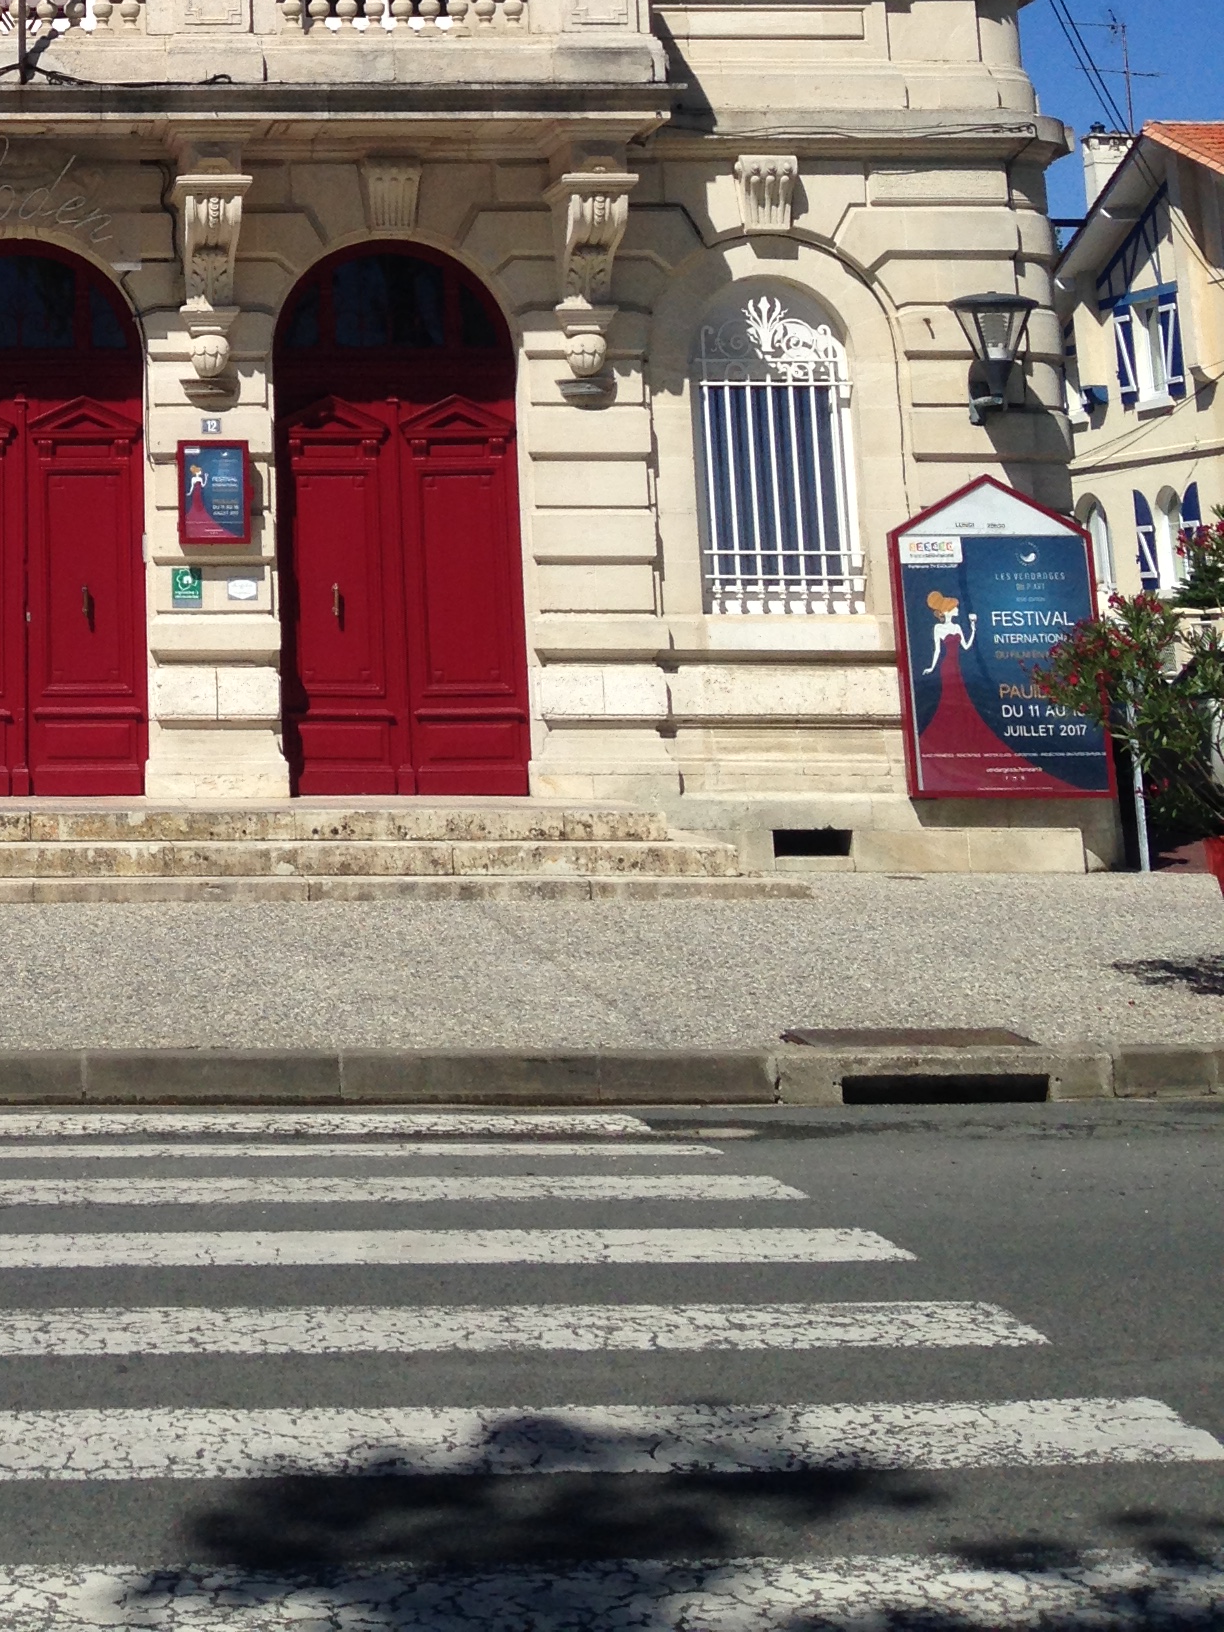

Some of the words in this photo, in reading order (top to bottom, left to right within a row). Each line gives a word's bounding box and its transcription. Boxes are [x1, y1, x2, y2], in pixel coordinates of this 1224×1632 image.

[206, 419, 217, 433] 12
[994, 572, 1011, 581] LES
[991, 611, 1075, 626] FESTIVAL
[1001, 704, 1023, 718] DU
[1028, 704, 1040, 717] 11
[1045, 704, 1066, 717] AU
[1003, 724, 1055, 737] JUILLET
[1060, 724, 1088, 736] 2017
